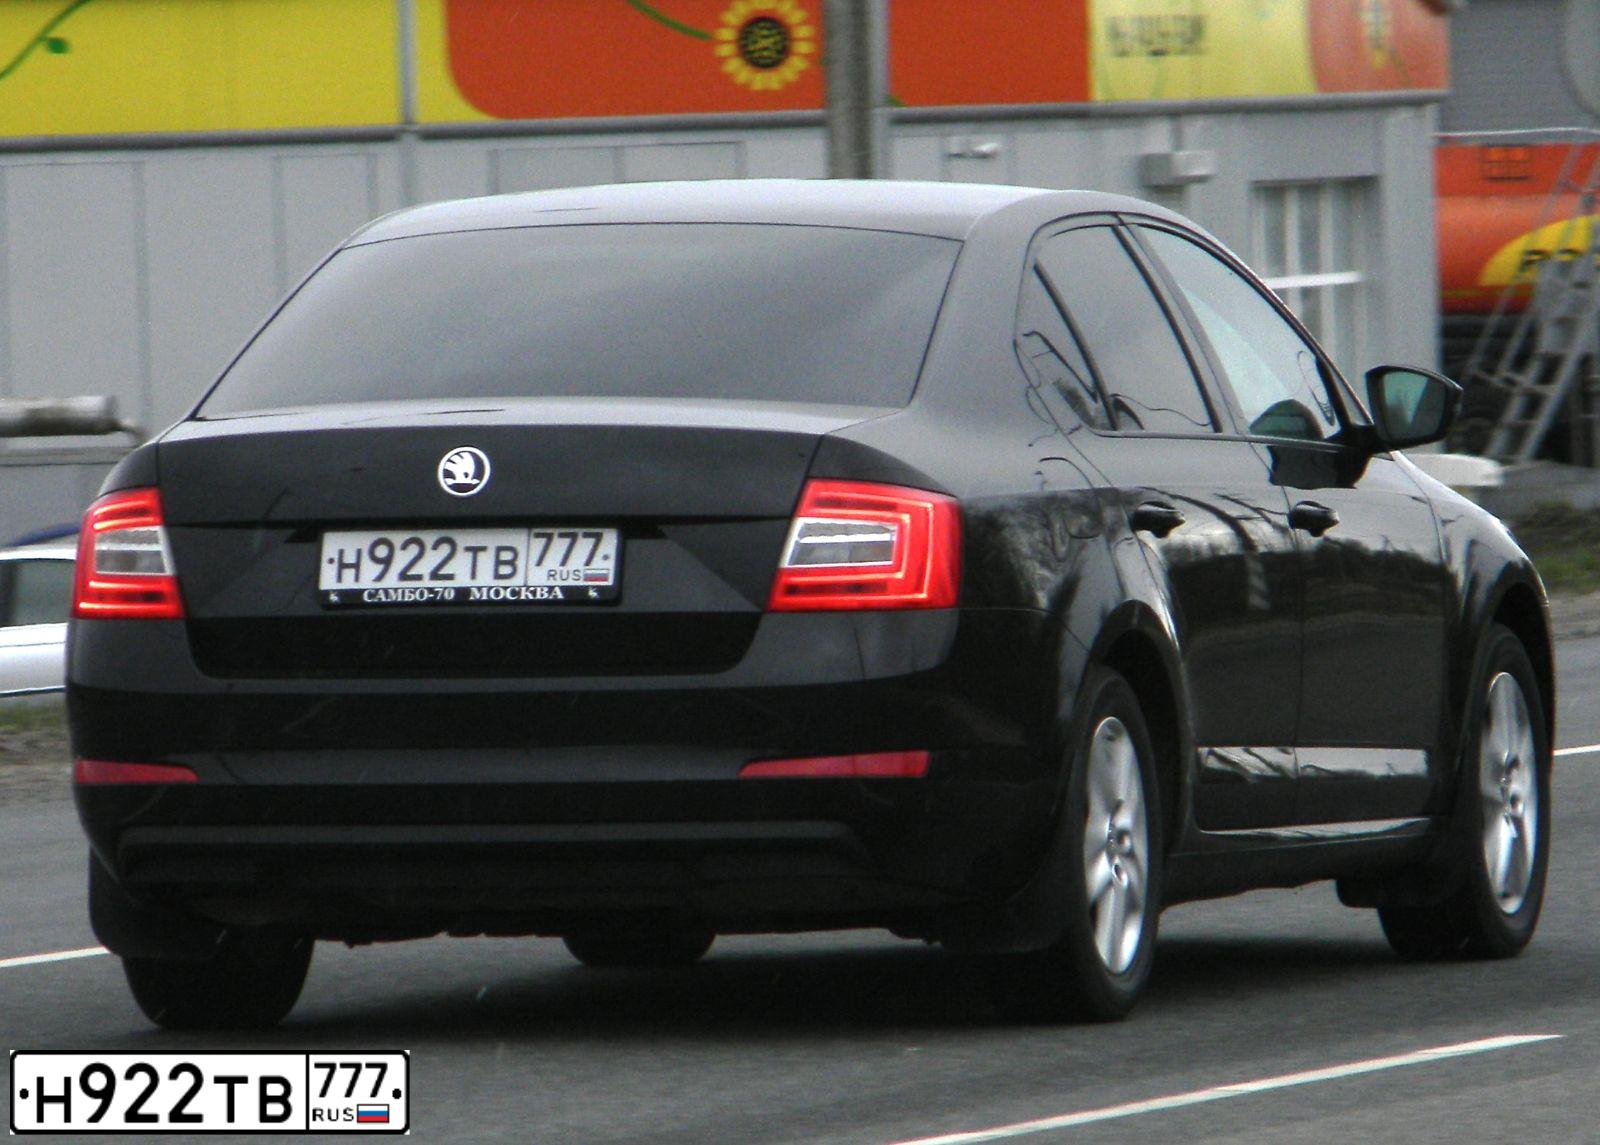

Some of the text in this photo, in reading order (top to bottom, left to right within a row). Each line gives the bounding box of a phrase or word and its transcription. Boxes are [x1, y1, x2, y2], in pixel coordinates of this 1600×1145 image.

[533, 532, 603, 567] 777
[547, 569, 581, 581] RUS
[362, 586, 565, 602] САМБО-70 МОСКВА
